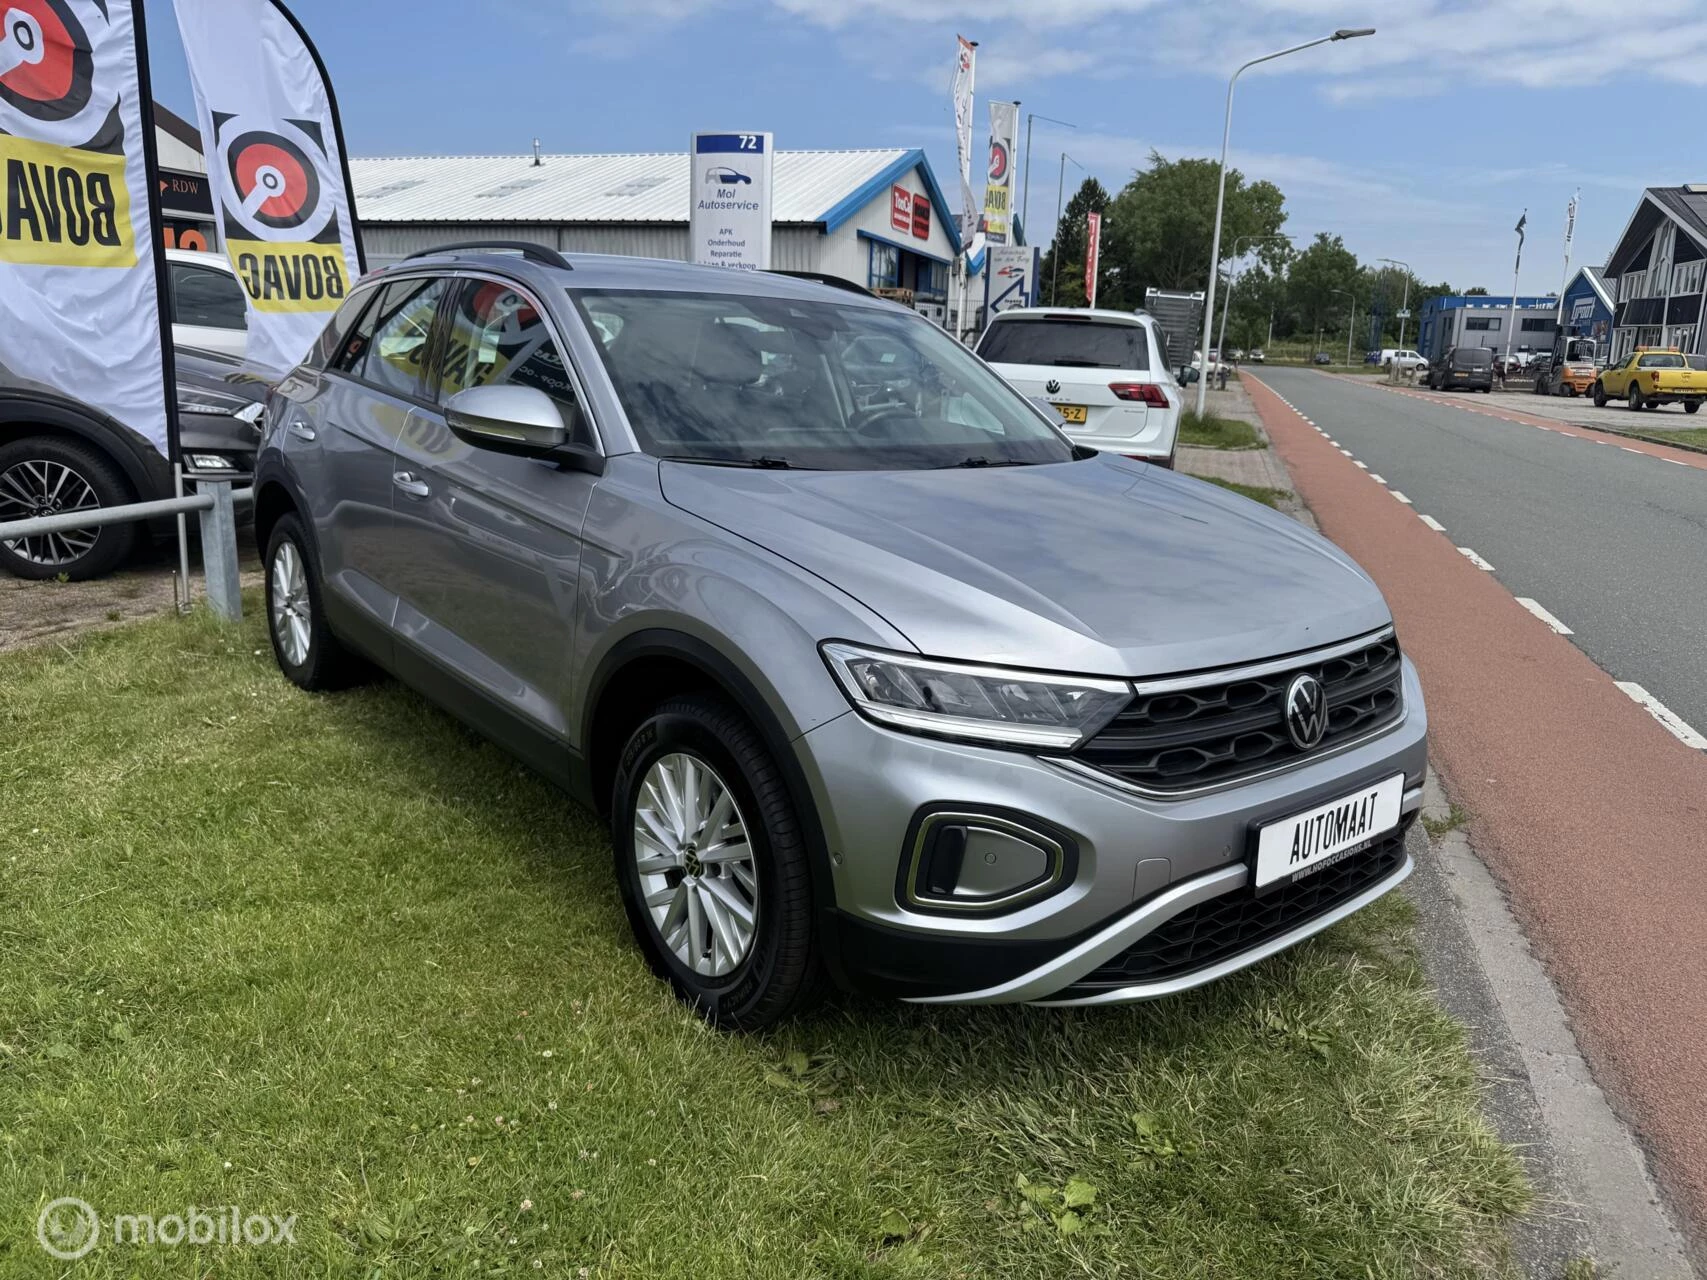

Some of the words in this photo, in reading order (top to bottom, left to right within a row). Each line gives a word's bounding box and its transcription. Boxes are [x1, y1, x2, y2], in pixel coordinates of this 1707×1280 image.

[739, 135, 757, 149] 72
[172, 179, 199, 195] RDW
[717, 188, 736, 198] Mol
[698, 199, 759, 211] Autoservice
[707, 239, 746, 247] Onderhoud
[710, 250, 742, 259] Reparatie
[1289, 792, 1378, 865] AUTOMAAT
